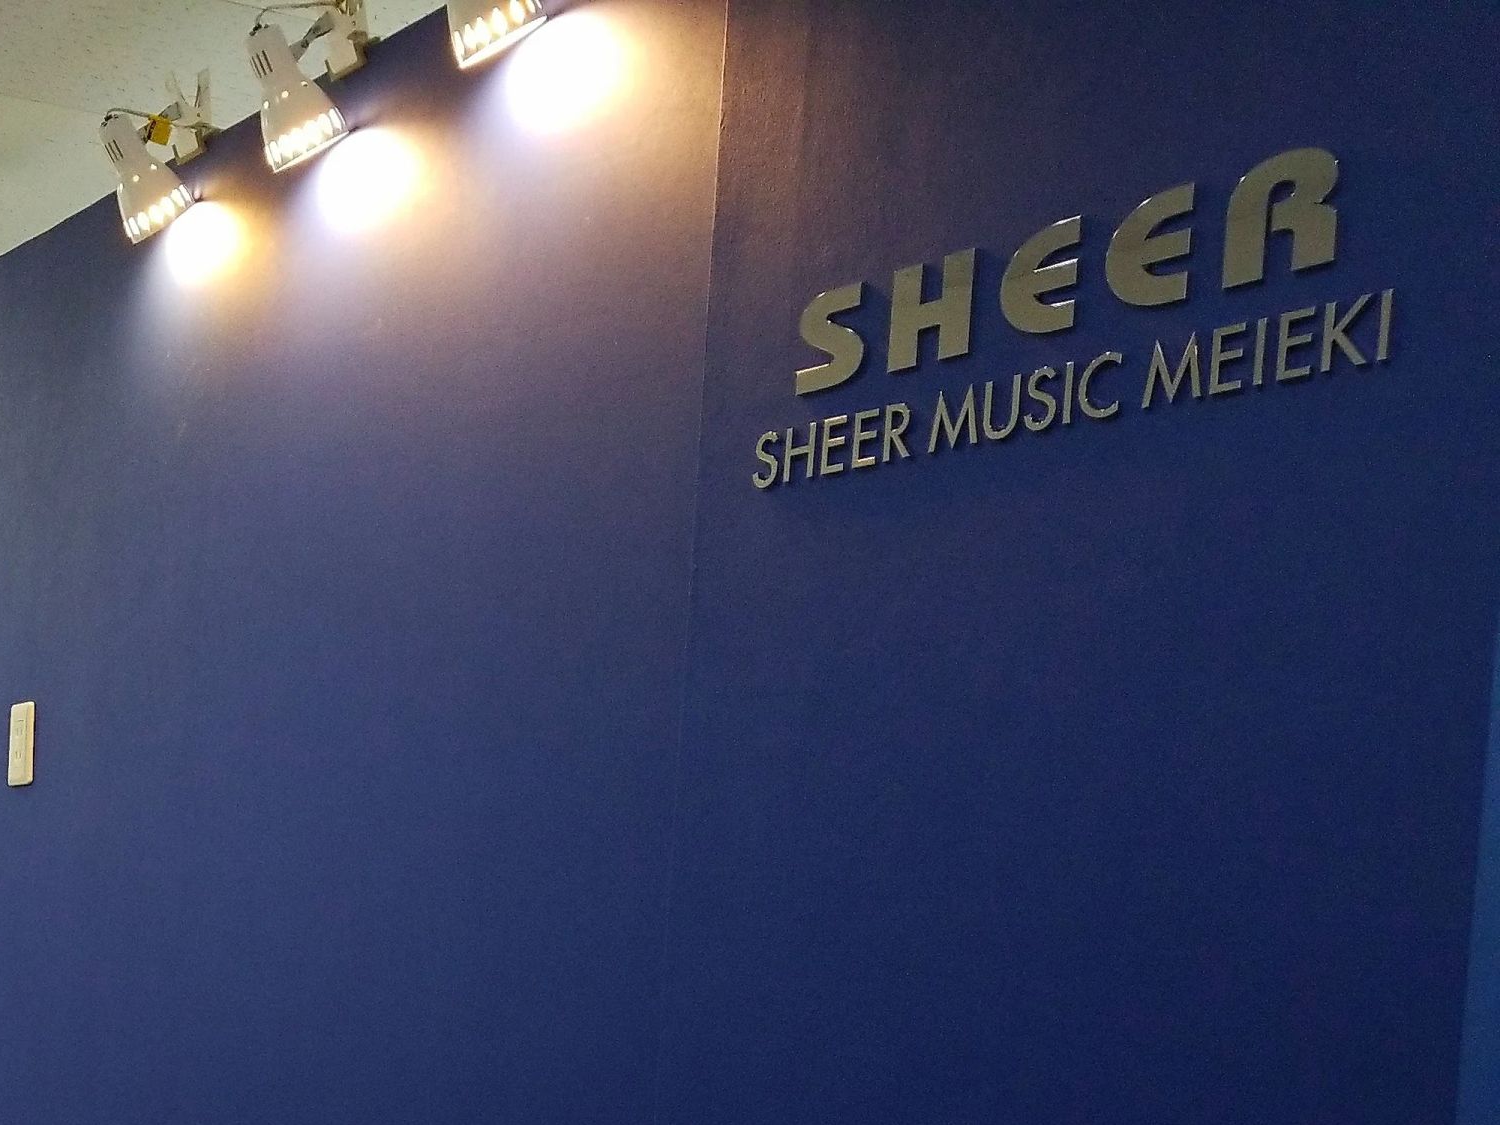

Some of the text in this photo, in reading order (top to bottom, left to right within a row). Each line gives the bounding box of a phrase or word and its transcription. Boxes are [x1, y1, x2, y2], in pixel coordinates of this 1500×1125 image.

[795, 147, 1339, 396] SHEER
[752, 287, 1395, 490] SHEER MUSIC MEIEKI
